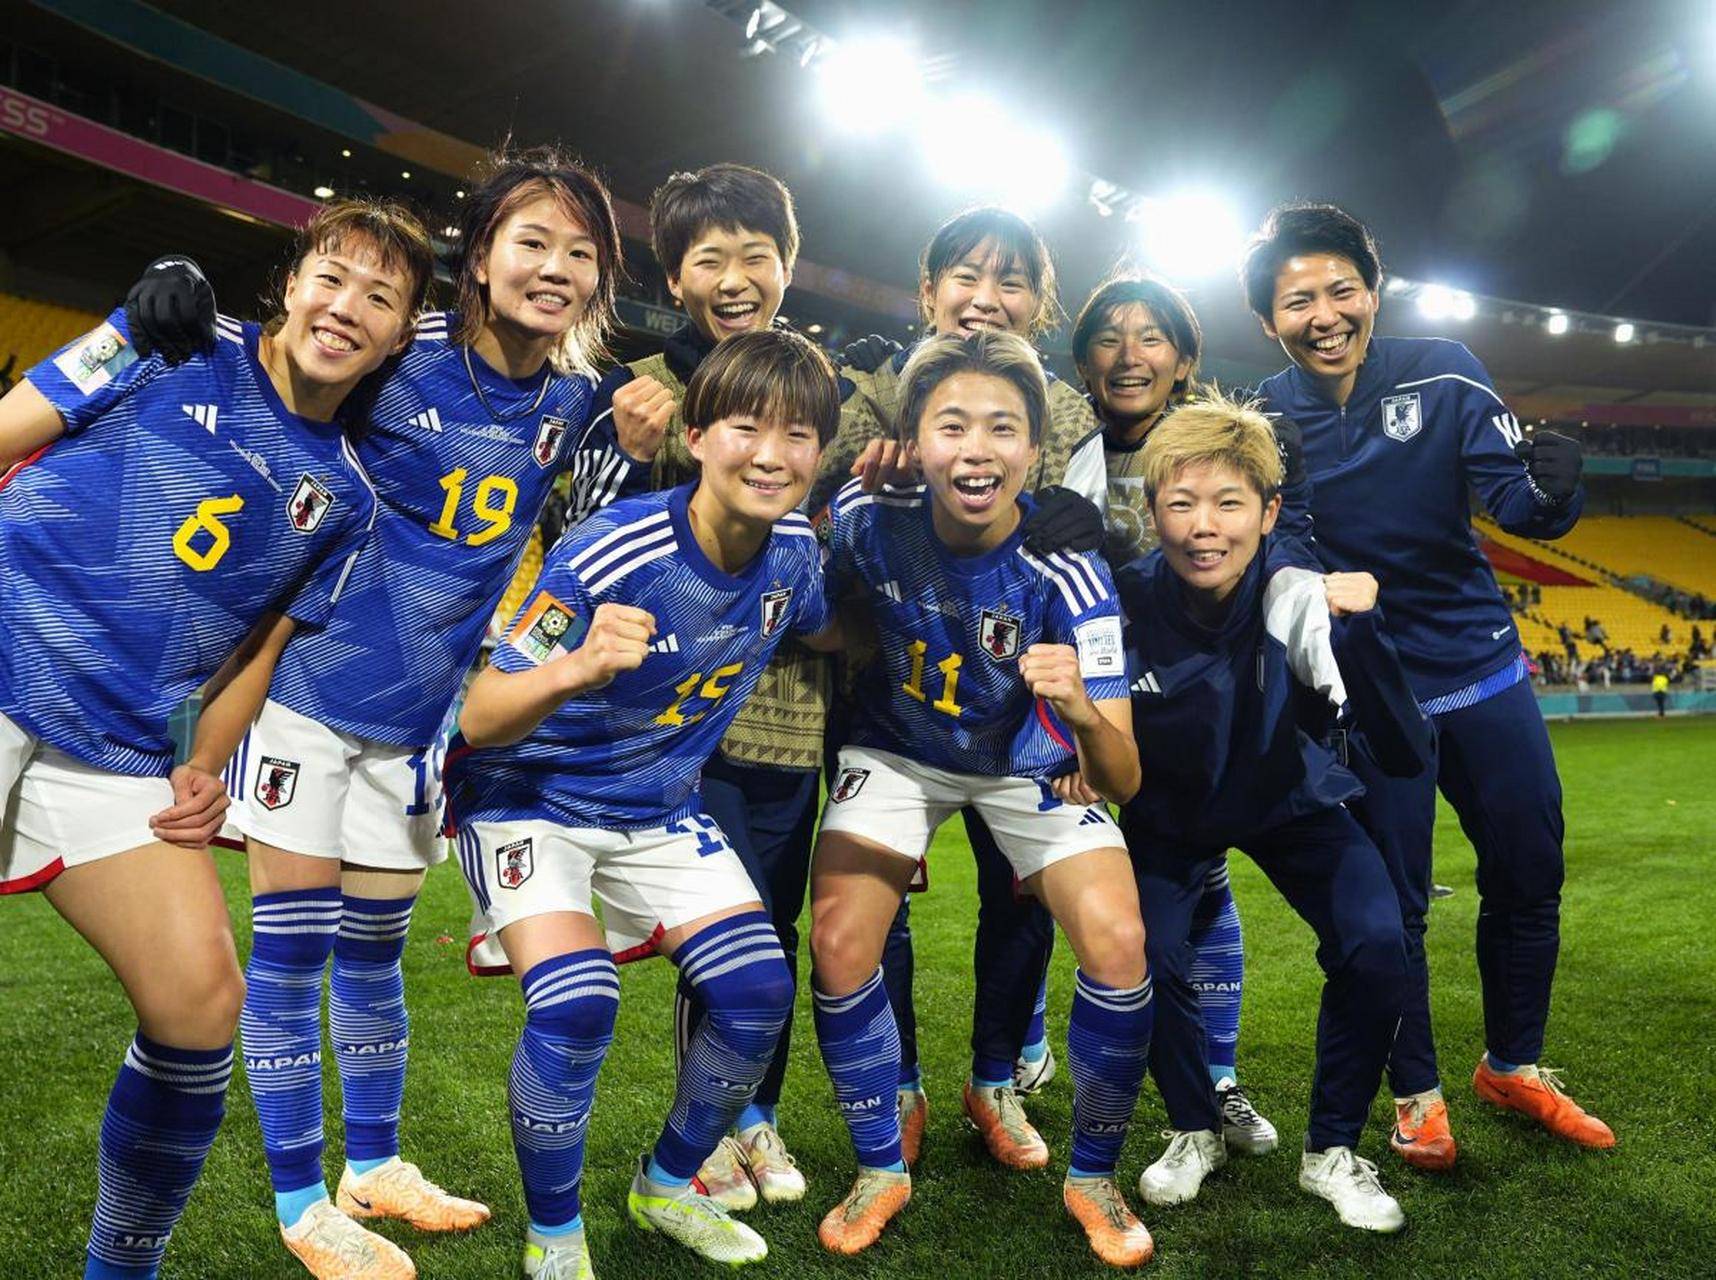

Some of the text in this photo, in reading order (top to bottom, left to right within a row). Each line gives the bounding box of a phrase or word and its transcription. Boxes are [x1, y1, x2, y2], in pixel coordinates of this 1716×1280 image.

[172, 494, 245, 572] 6
[429, 468, 519, 547] 19
[903, 638, 963, 717] 11
[245, 1051, 320, 1071] JAPAN
